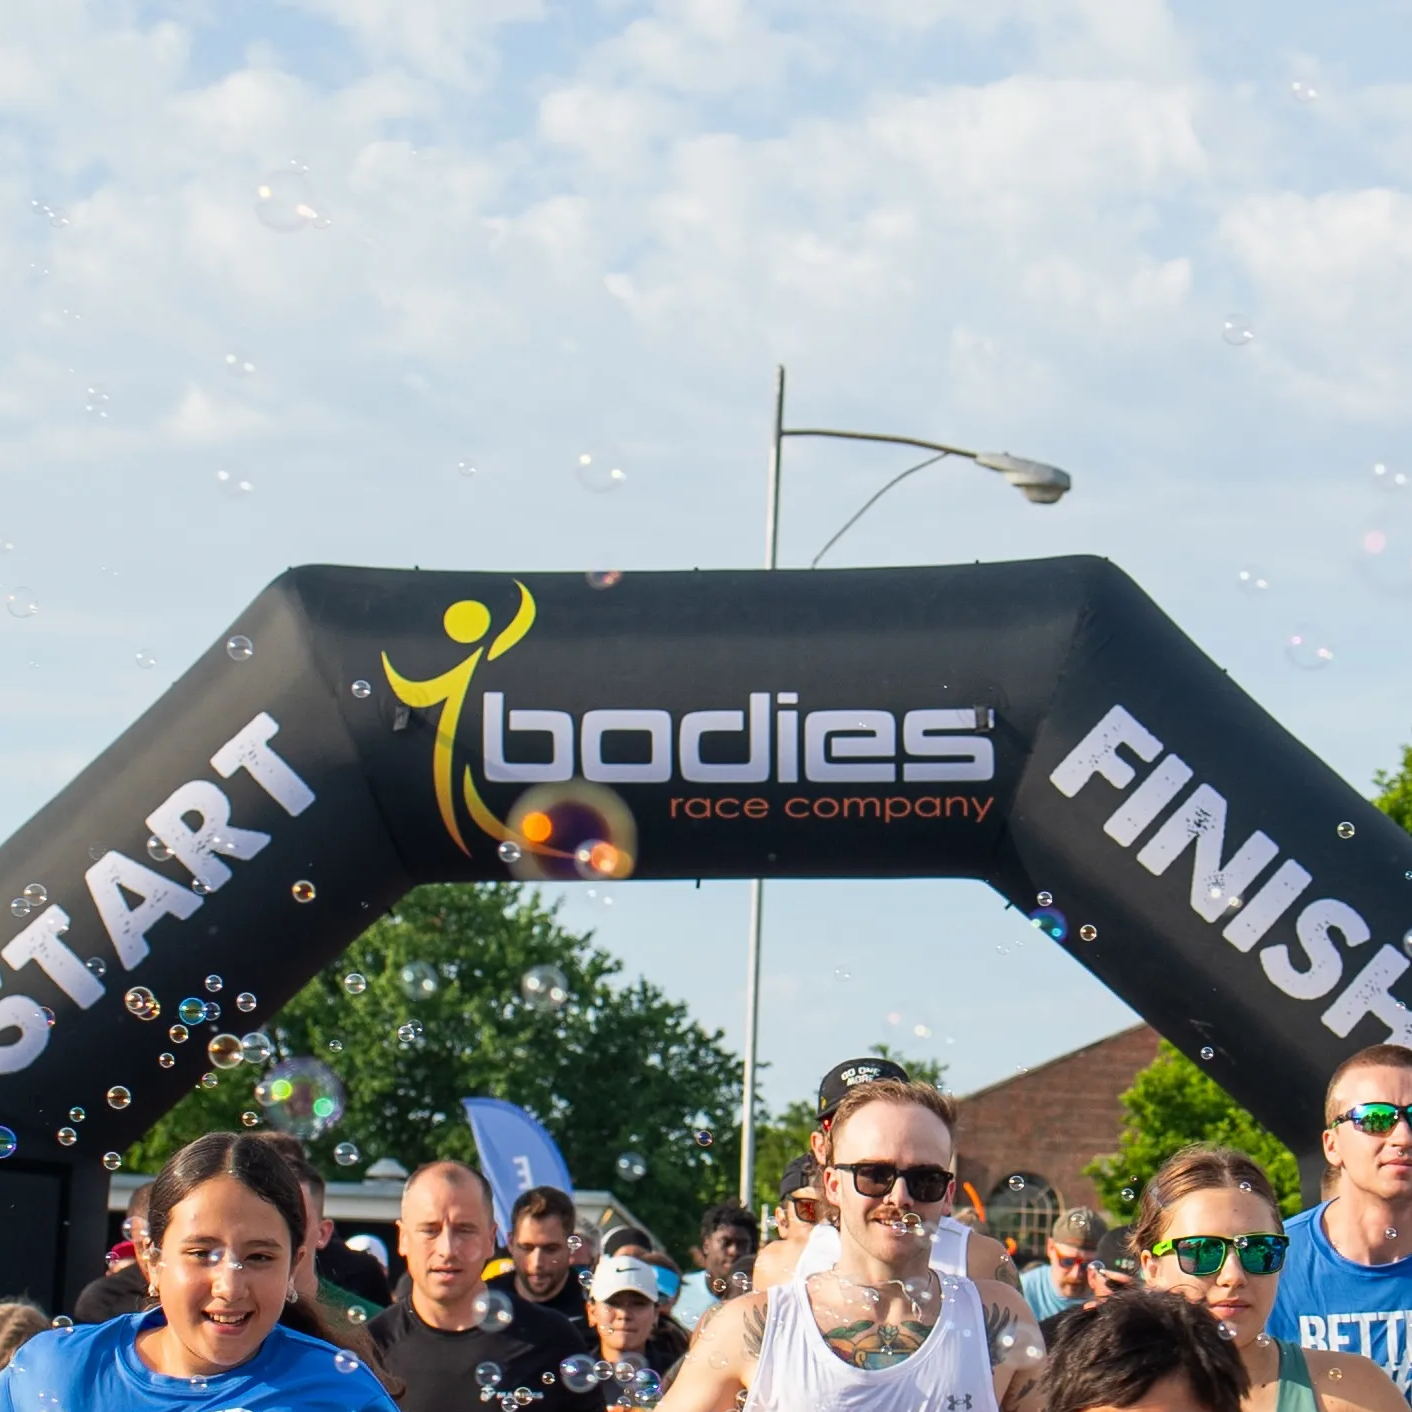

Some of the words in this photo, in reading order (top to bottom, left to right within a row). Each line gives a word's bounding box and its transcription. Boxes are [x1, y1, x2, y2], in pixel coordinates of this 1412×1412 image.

[483, 692, 995, 783] bodies
[670, 797, 770, 819] race
[785, 797, 994, 822] company
